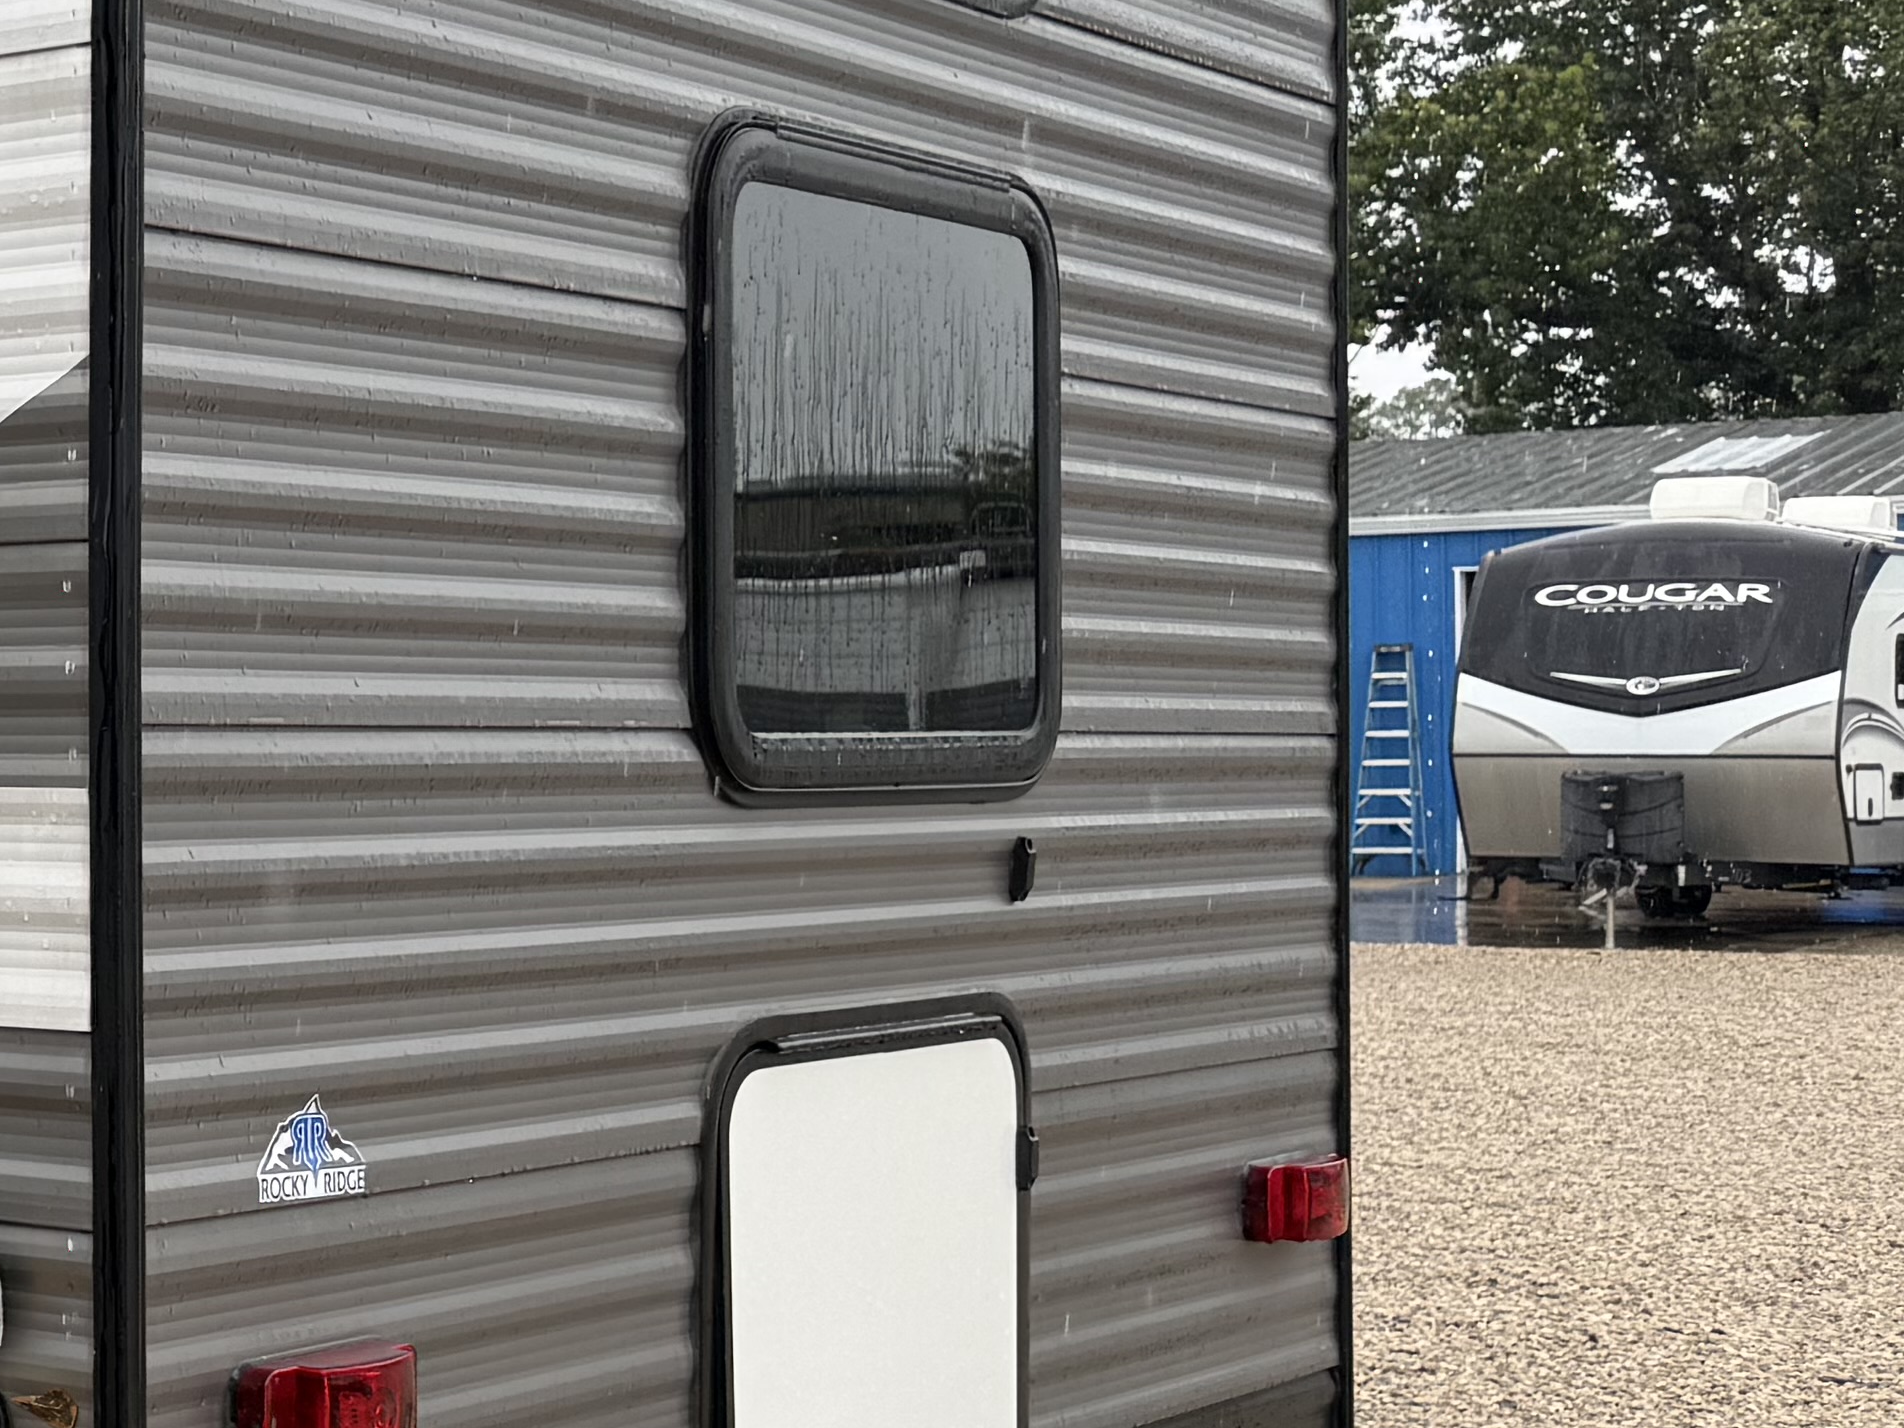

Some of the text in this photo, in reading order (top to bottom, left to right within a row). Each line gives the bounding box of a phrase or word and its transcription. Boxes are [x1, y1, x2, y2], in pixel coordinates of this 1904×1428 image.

[1534, 582, 1774, 607] COUGAR
[261, 1169, 365, 1201] ROCKY RIDGE
